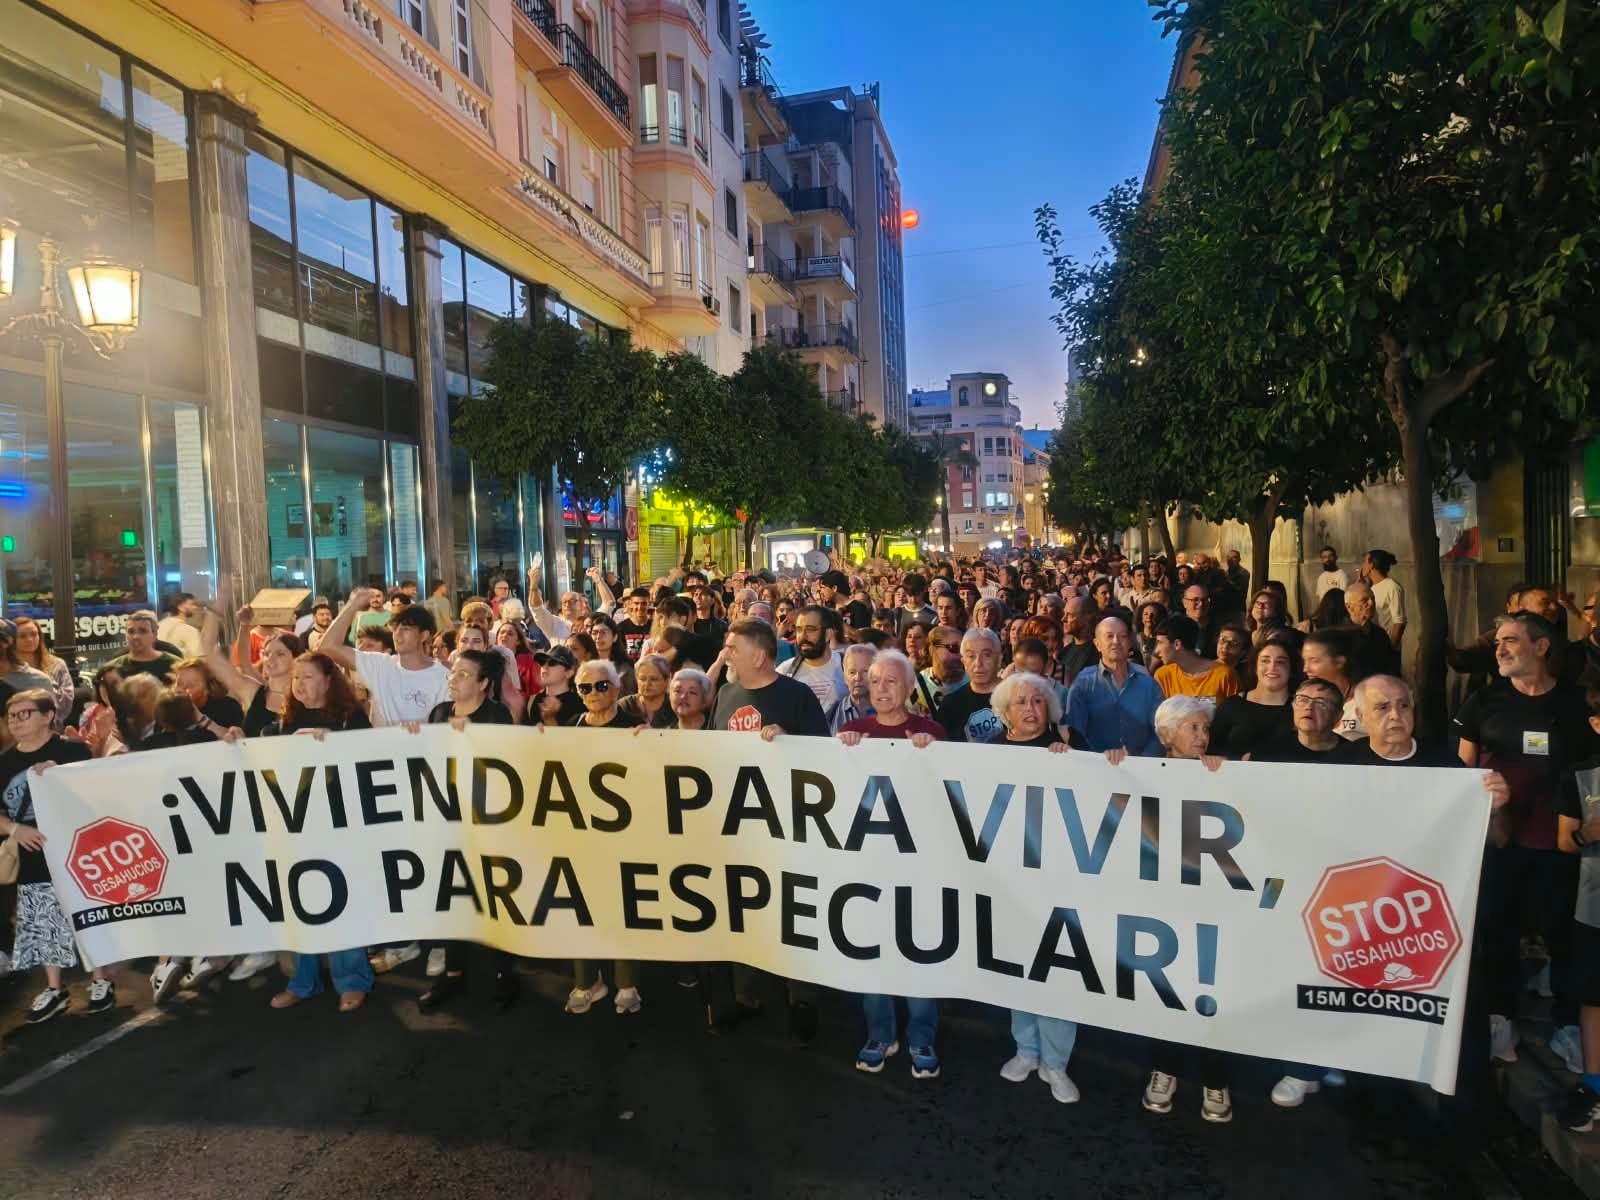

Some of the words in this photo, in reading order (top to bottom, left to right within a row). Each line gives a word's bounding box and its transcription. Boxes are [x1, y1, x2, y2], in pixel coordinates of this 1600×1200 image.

[729, 713, 760, 731] STOP
[969, 716, 998, 738] STOP
[162, 757, 633, 855] ¡VIVIENDAS
[664, 765, 917, 854] PARA
[943, 779, 1285, 910] VIVIR,
[78, 833, 146, 881] STOP
[92, 856, 162, 897] DESAHUCIOS
[78, 908, 110, 925] 15M
[112, 900, 183, 918] CÓRDOBA
[1319, 889, 1433, 948] STOP
[225, 858, 349, 927] NO
[383, 849, 595, 926] PARA
[620, 861, 1220, 1018] ESPECULAR!
[1332, 930, 1449, 972] DESAHUCIOS
[1304, 990, 1346, 1007] 15M
[1352, 989, 1450, 1018] CÓRDOB
